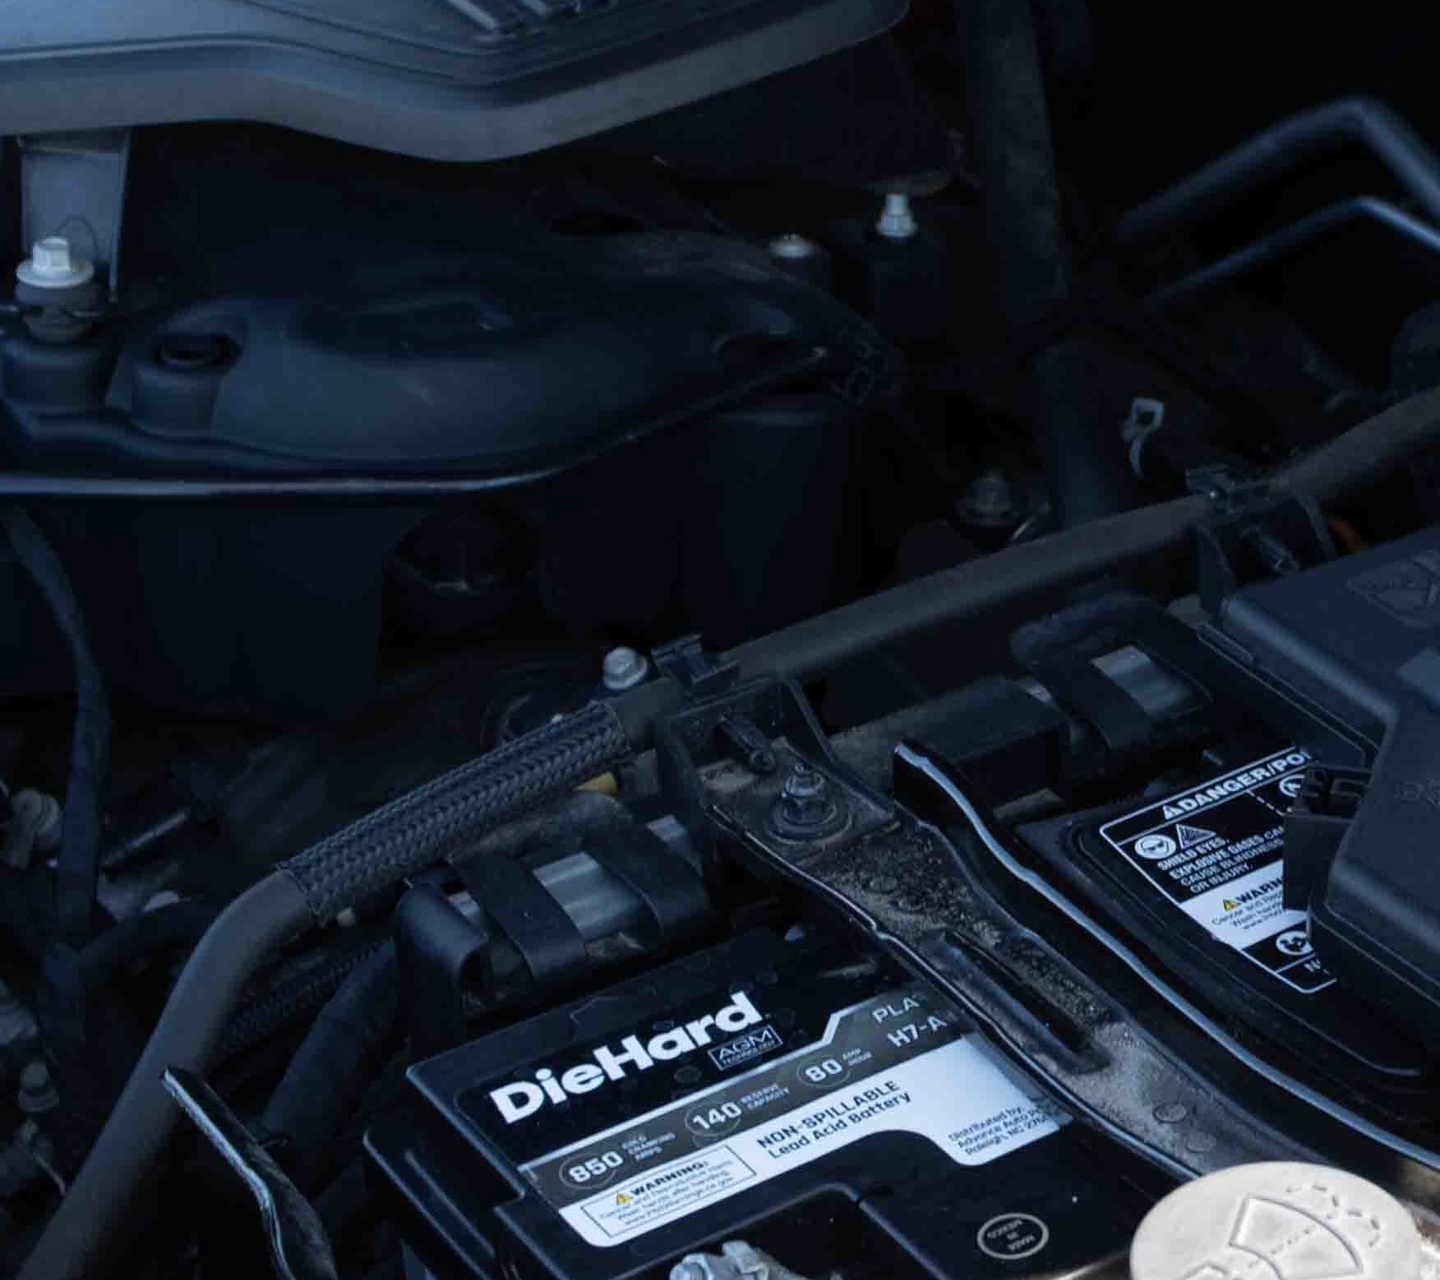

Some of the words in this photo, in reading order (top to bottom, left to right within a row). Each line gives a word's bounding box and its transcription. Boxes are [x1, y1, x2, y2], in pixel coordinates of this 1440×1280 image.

[1157, 848, 1198, 871] SHIELD
[1169, 848, 1230, 880] EXPLOSIVE
[1227, 834, 1265, 854] GASES
[1180, 864, 1220, 887] CAUSE
[1190, 881, 1210, 894] OR
[489, 991, 763, 1124] DieHard
[718, 1030, 774, 1060] AGM
[805, 1058, 843, 1082] 80
[692, 1101, 742, 1130] 140
[757, 1080, 902, 1149] NON-SPILLABLE
[767, 1133, 811, 1159] Lead
[813, 1118, 848, 1141] Acid
[849, 1092, 912, 1125] Battery
[568, 1151, 624, 1183] 850
[629, 1159, 709, 1196] WARNING:
